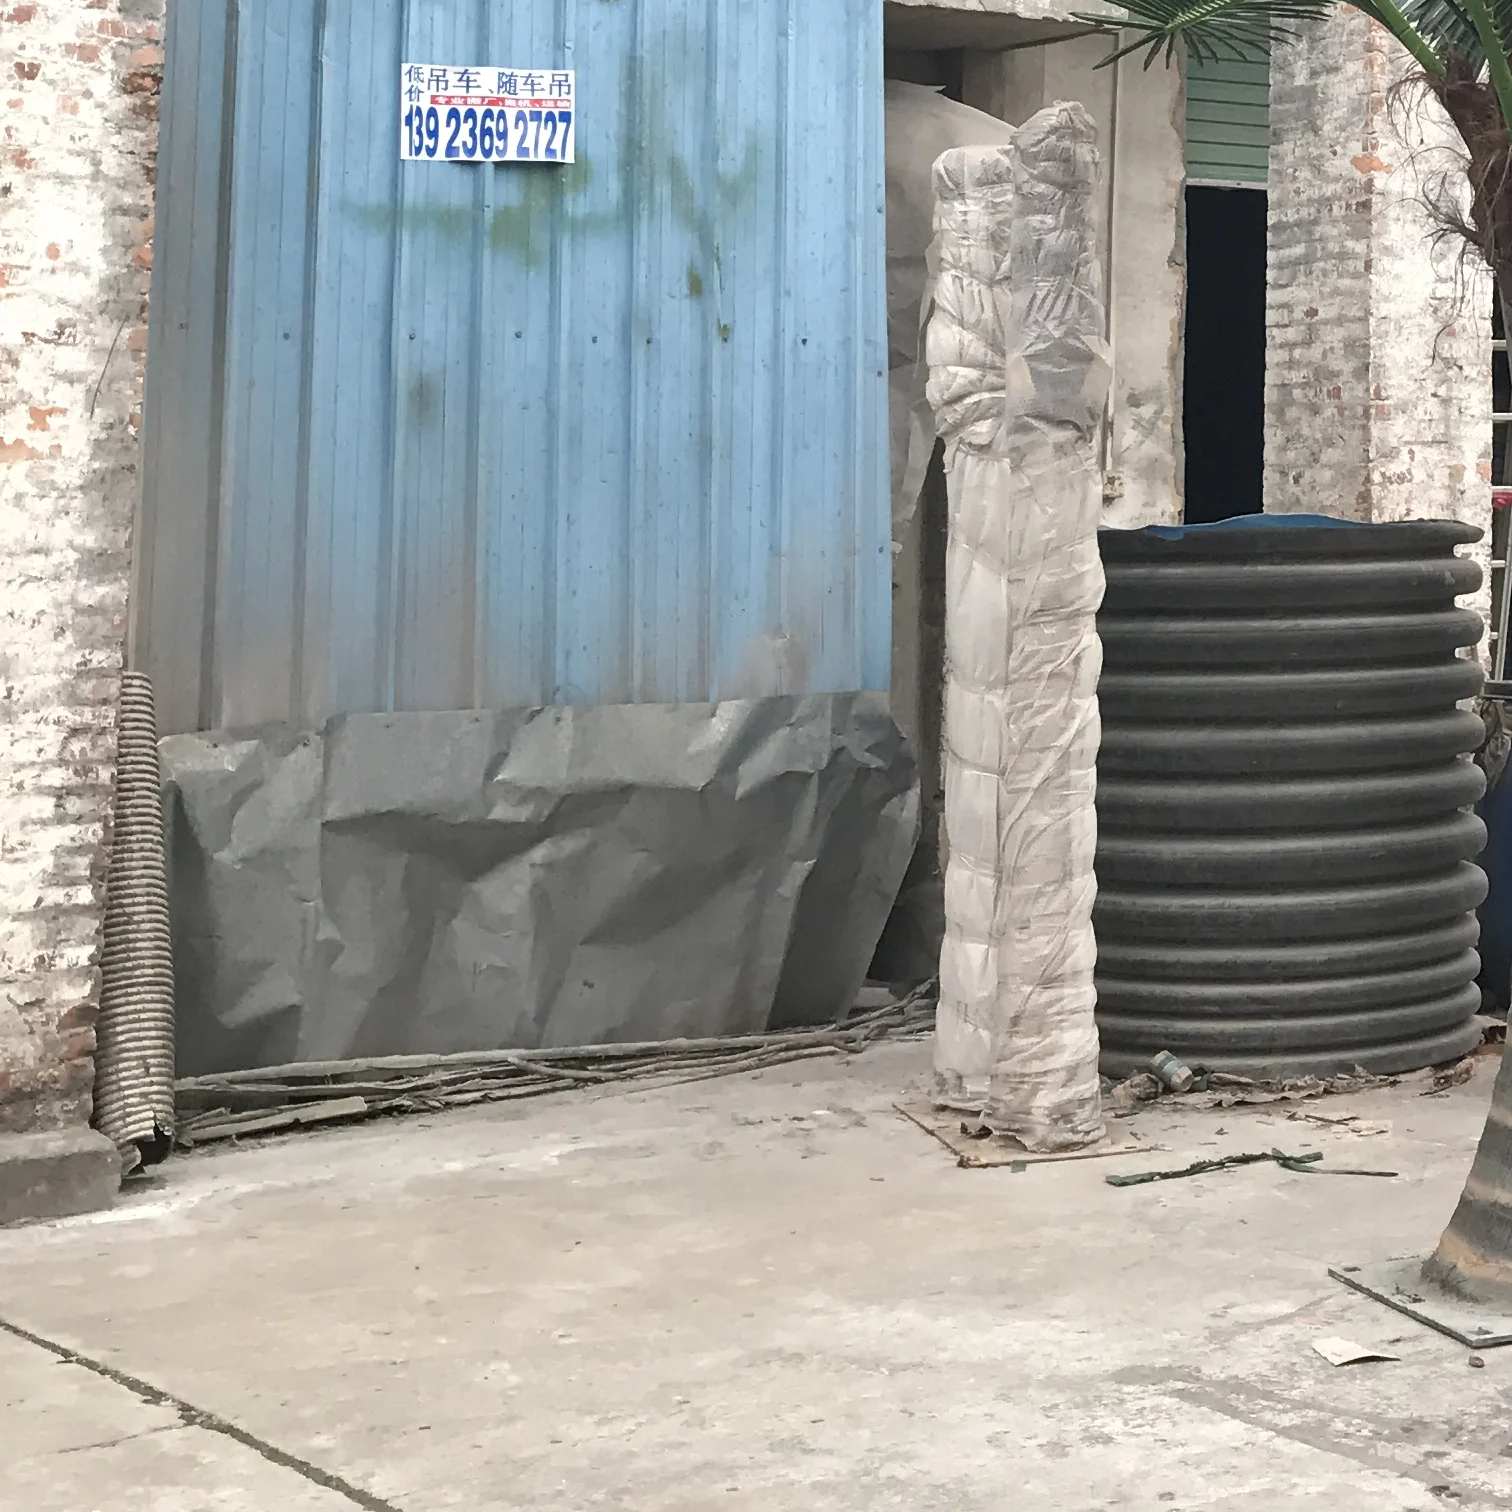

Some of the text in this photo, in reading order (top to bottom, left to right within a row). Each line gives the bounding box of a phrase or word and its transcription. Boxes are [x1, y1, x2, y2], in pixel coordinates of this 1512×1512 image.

[404, 65, 425, 102] 低价
[427, 68, 572, 96] 吊车、随车吊
[404, 105, 572, 160] 139 2369 2727
